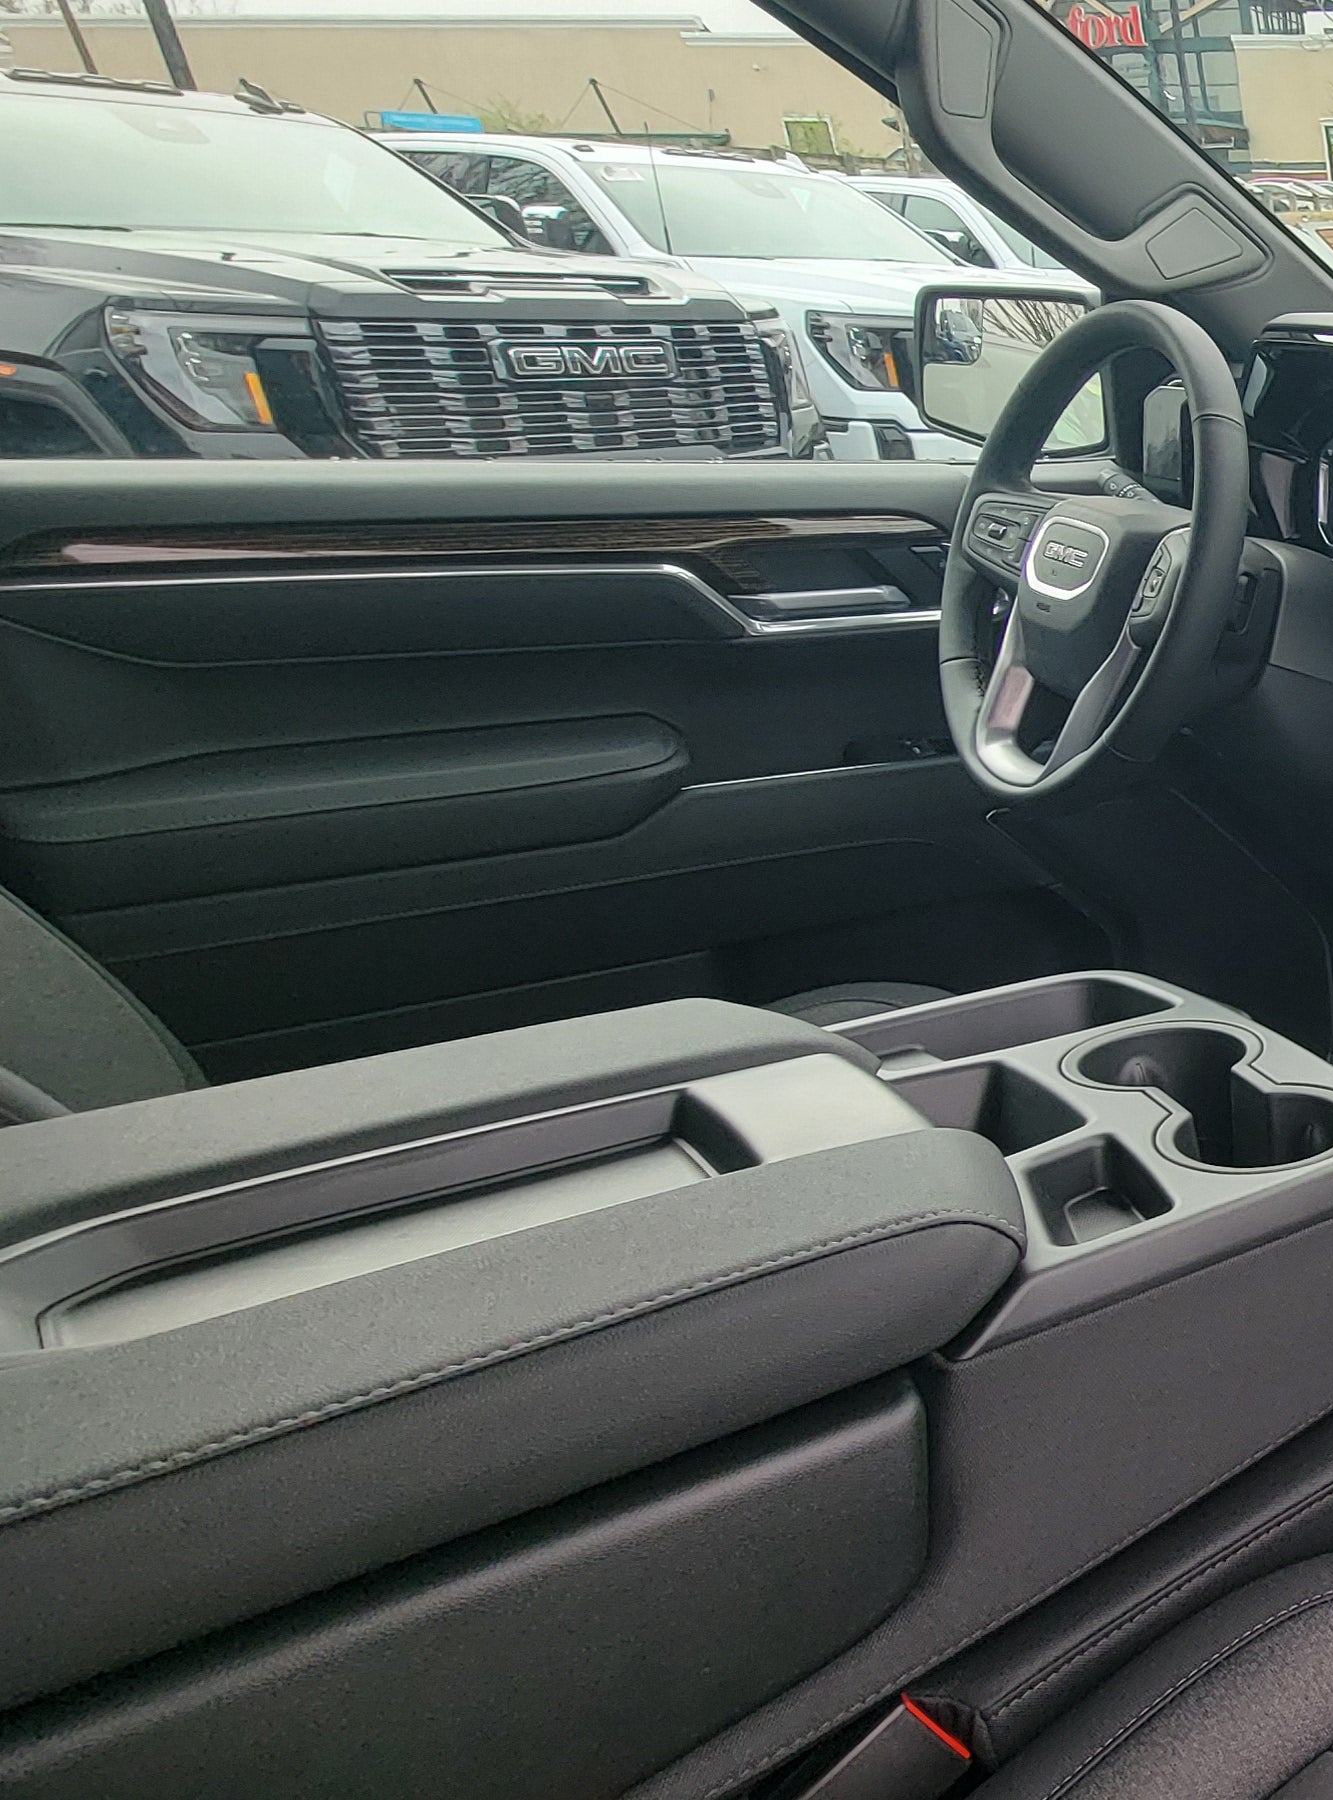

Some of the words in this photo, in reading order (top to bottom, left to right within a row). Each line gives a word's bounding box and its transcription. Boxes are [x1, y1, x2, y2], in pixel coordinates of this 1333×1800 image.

[1068, 5, 1148, 49] ford
[508, 346, 668, 375] GMC
[1044, 540, 1088, 568] GMC
